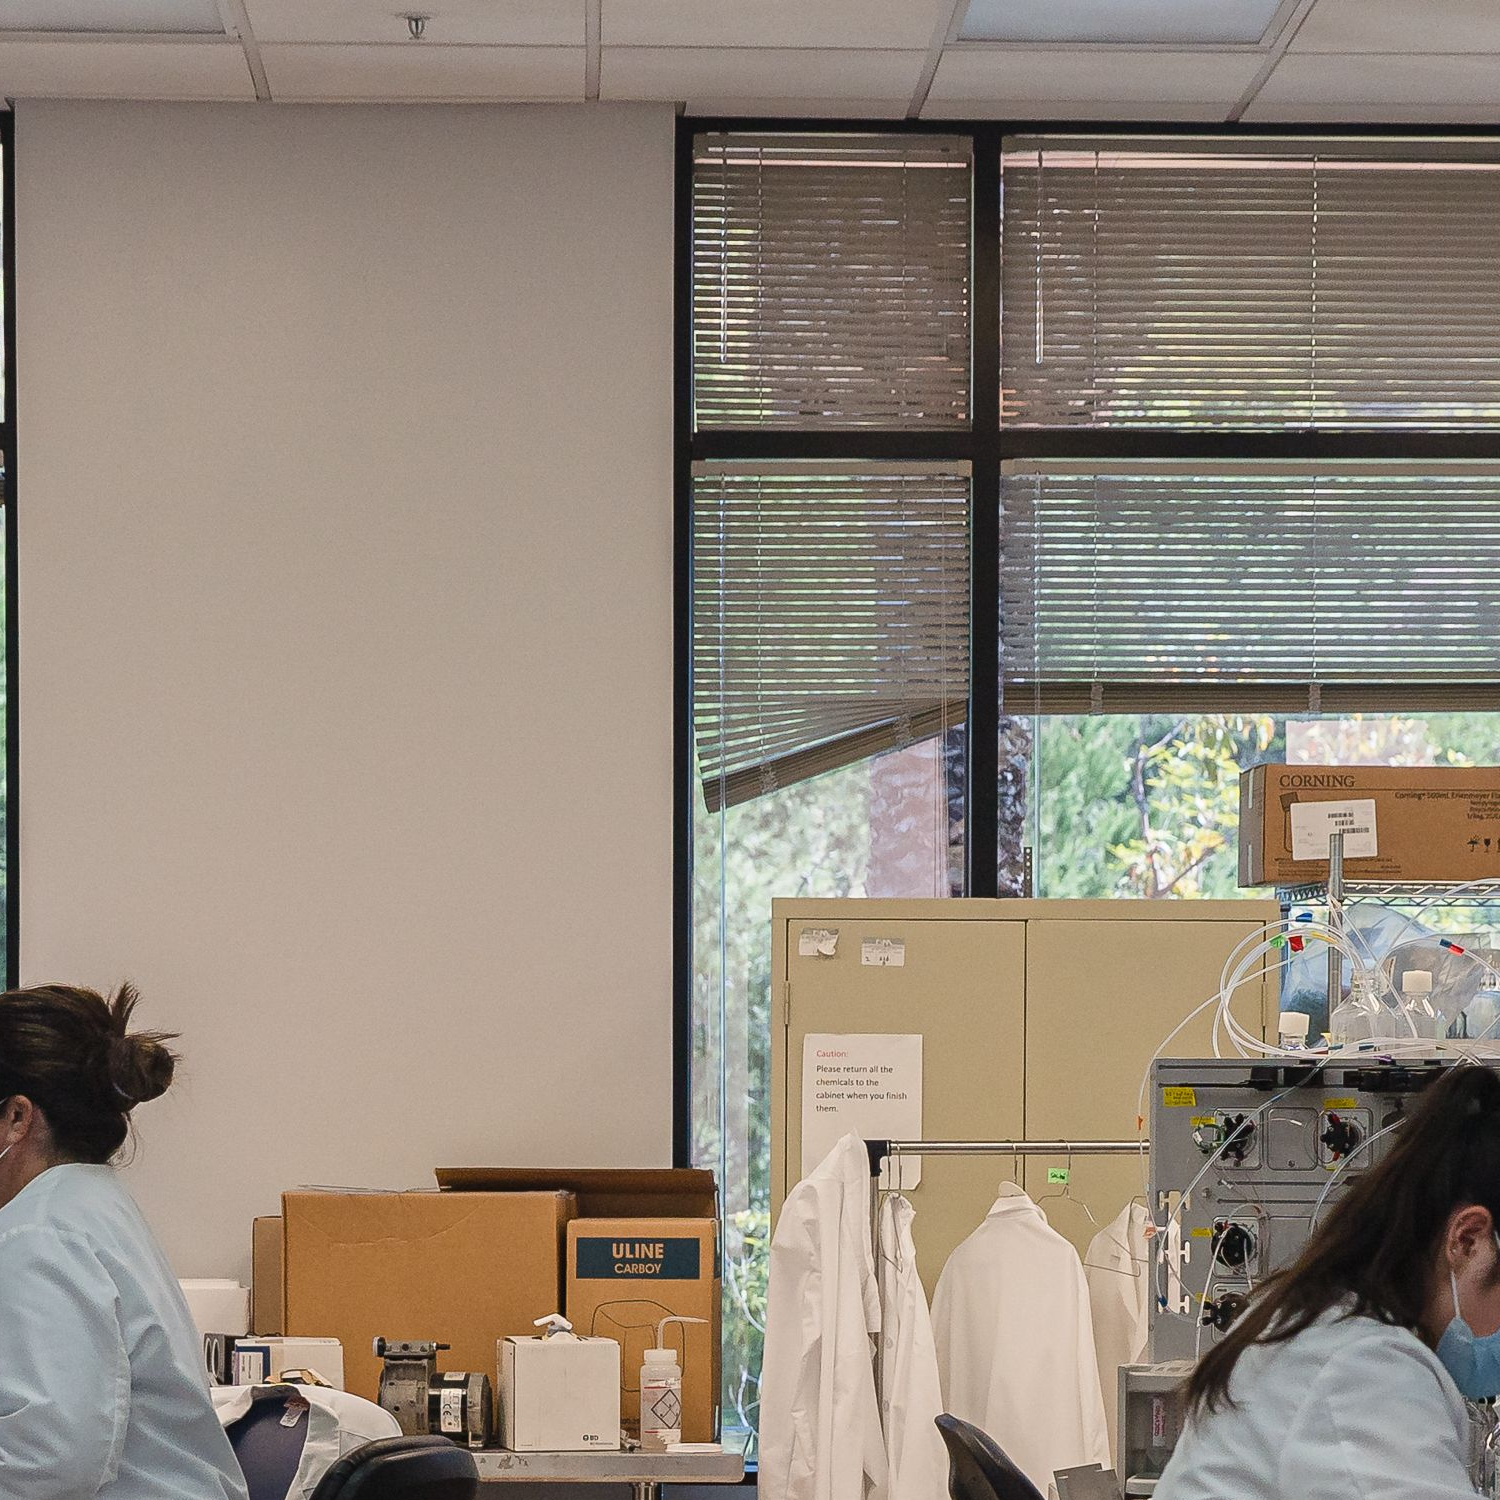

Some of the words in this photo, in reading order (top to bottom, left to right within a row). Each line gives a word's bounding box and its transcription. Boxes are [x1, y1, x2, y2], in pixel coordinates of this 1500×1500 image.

[1279, 774, 1356, 788] CORNING
[816, 1049, 848, 1058] Caution:
[816, 1065, 841, 1073] Please
[869, 1065, 879, 1073] all
[880, 1065, 894, 1074] the
[816, 1078, 854, 1086] chemicals
[855, 1079, 865, 1087] to
[866, 1079, 879, 1087] the
[815, 1091, 845, 1100] cabinet
[846, 1092, 868, 1100] when
[869, 1093, 885, 1102] you
[886, 1091, 908, 1100] finish
[816, 1105, 839, 1113] them.
[612, 1242, 664, 1259] ULINE
[614, 1263, 662, 1274] CARBOY
